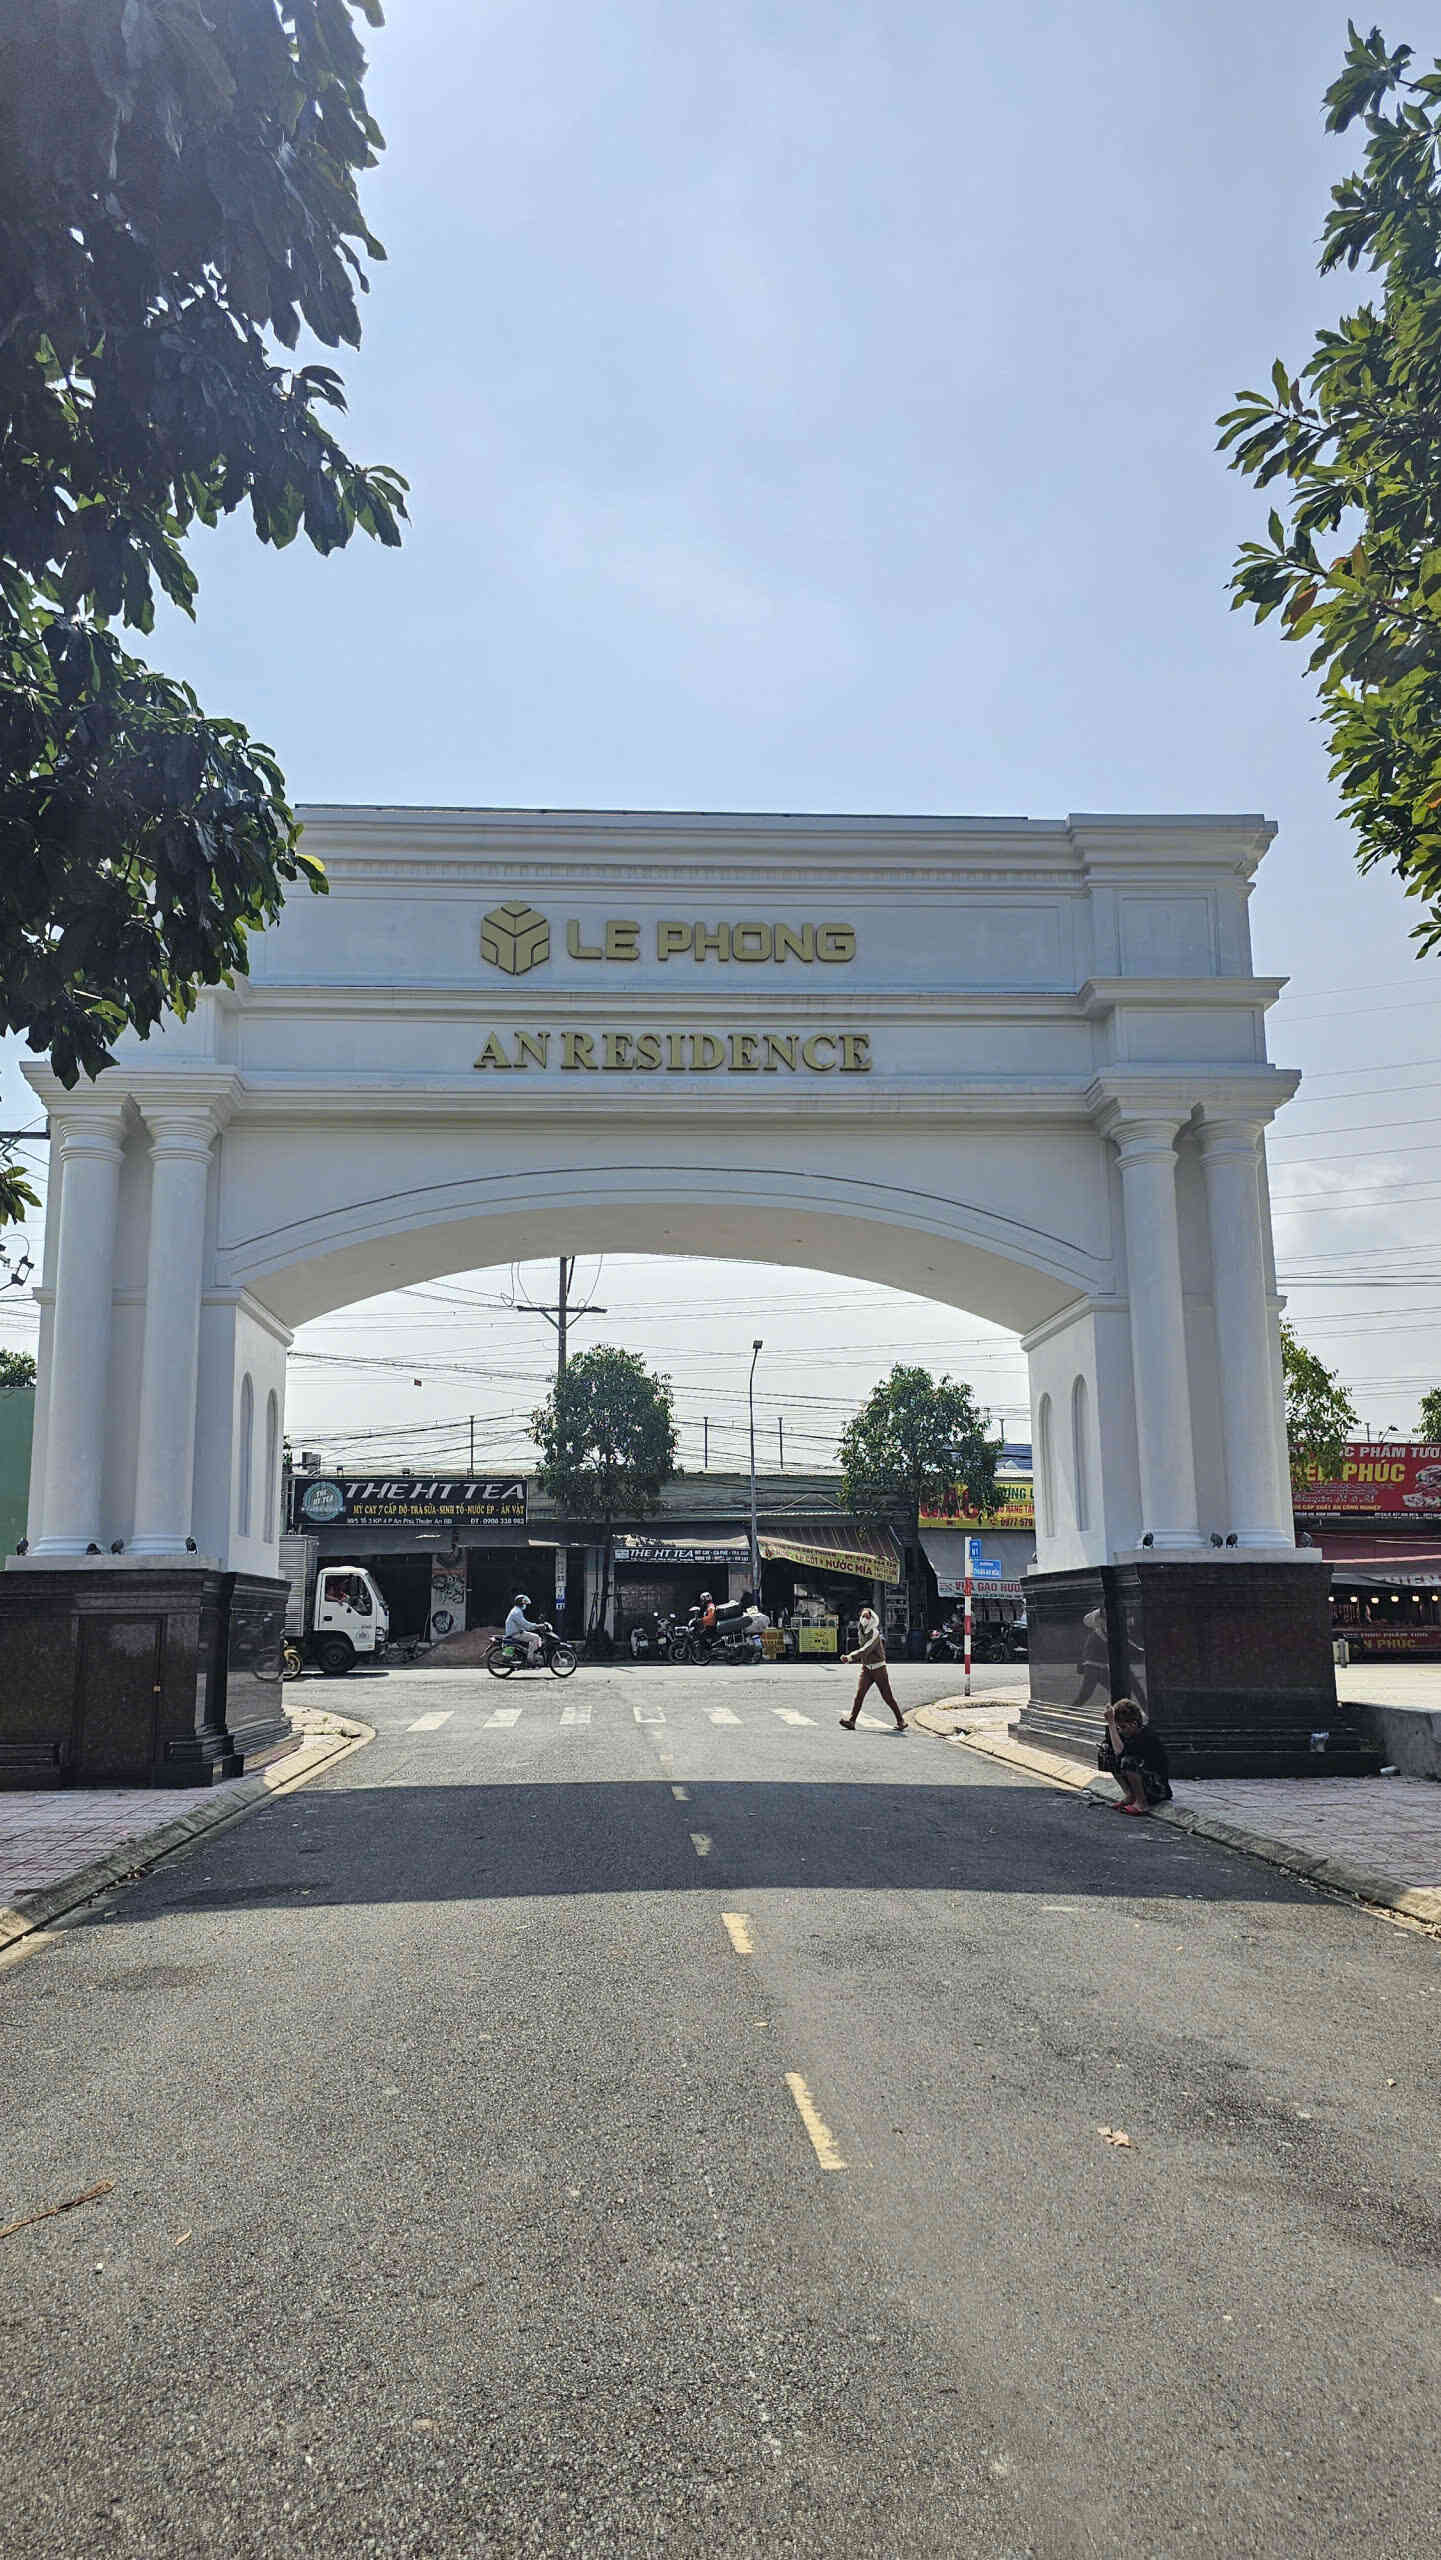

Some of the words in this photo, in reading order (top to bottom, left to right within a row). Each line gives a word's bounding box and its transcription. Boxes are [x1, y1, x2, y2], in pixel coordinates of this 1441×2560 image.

[566, 918, 640, 961] LE
[656, 920, 857, 963] PHONG
[473, 1030, 550, 1069] AN
[560, 1031, 873, 1072] RESIDENCE
[1342, 1460, 1406, 1482] PHÚC
[345, 1481, 408, 1499] THE
[409, 1482, 461, 1499] HT
[464, 1483, 524, 1499] TEA
[630, 1549, 652, 1557] THE
[673, 1549, 694, 1558] TEA
[825, 1559, 853, 1572] NƯỚC
